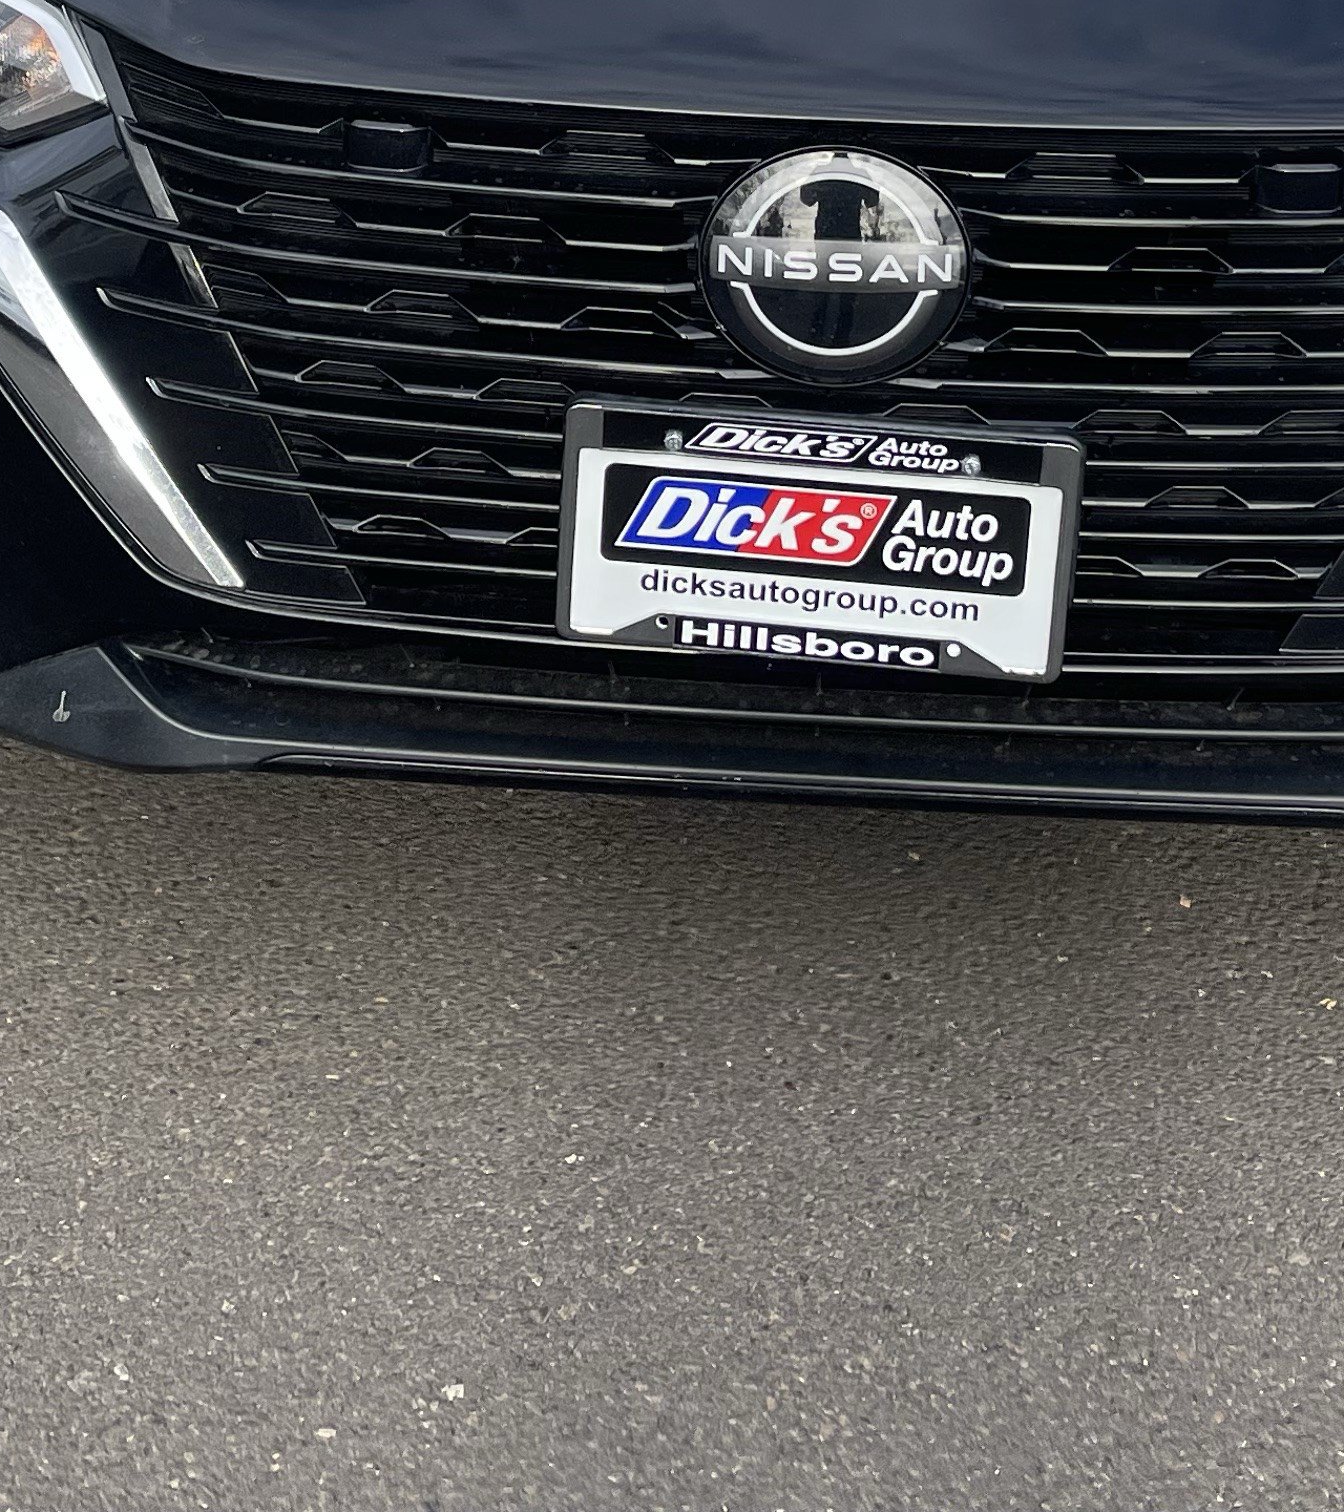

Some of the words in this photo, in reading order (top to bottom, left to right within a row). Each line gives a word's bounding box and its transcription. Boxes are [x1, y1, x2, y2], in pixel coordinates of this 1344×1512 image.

[717, 244, 952, 283] NISSAN
[868, 451, 960, 474] Group
[876, 437, 948, 457] Auto
[892, 499, 999, 542] Auto
[882, 535, 1014, 587] Group
[640, 569, 979, 622] dicksautogroup.com
[680, 619, 935, 667] Hillsboro
